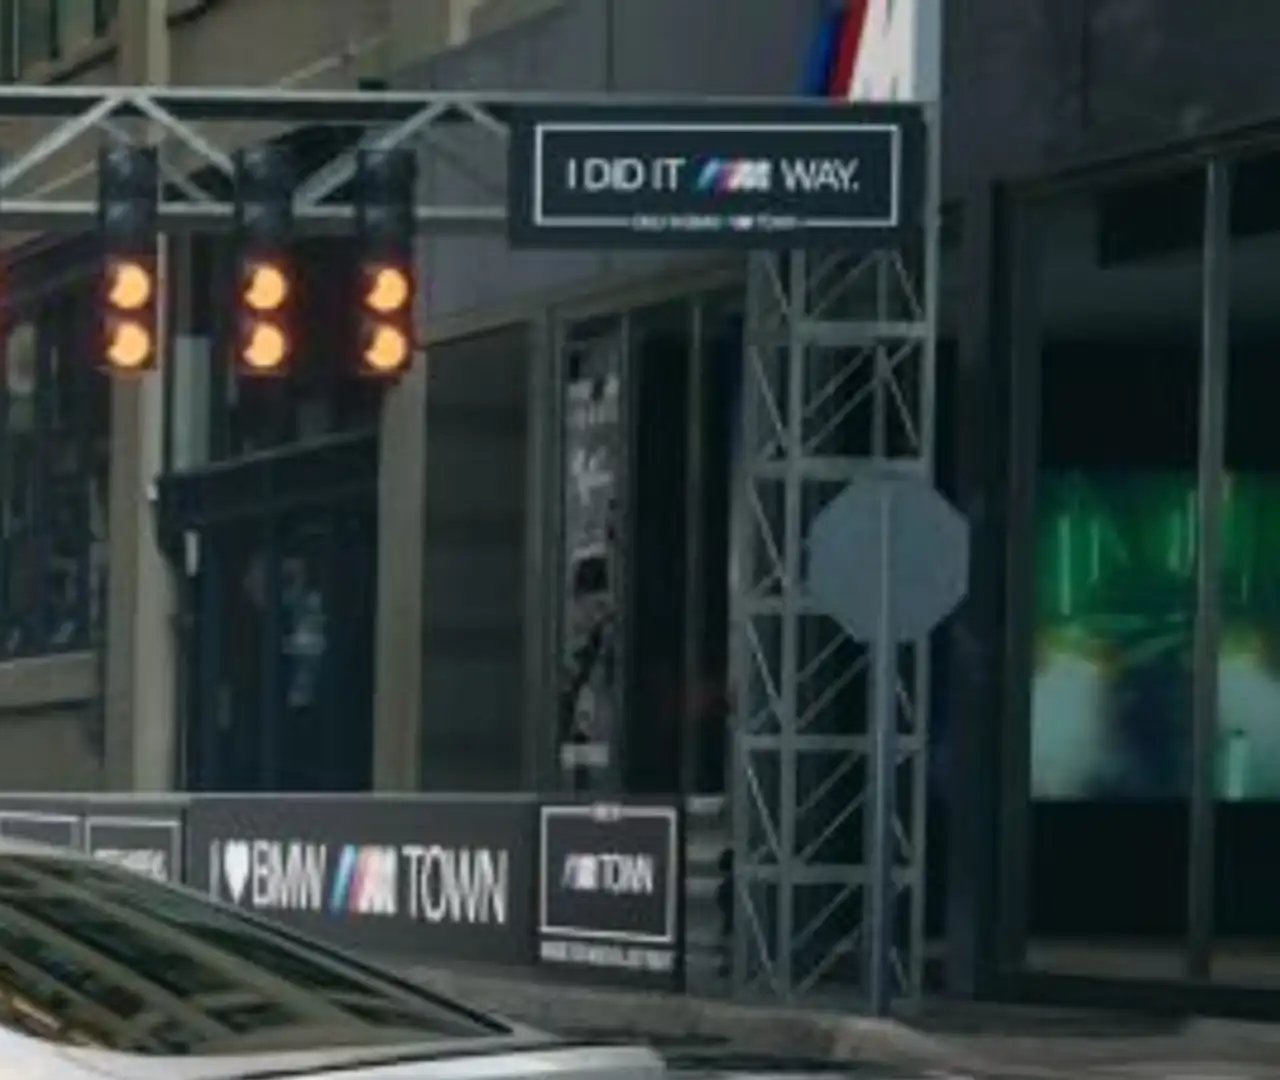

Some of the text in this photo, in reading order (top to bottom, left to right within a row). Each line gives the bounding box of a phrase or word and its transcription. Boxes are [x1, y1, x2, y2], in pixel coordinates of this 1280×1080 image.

[567, 158, 576, 190] I
[584, 158, 645, 190] DID
[653, 158, 688, 190] IT
[779, 158, 861, 191] WAY.
[404, 845, 509, 925] TOWN
